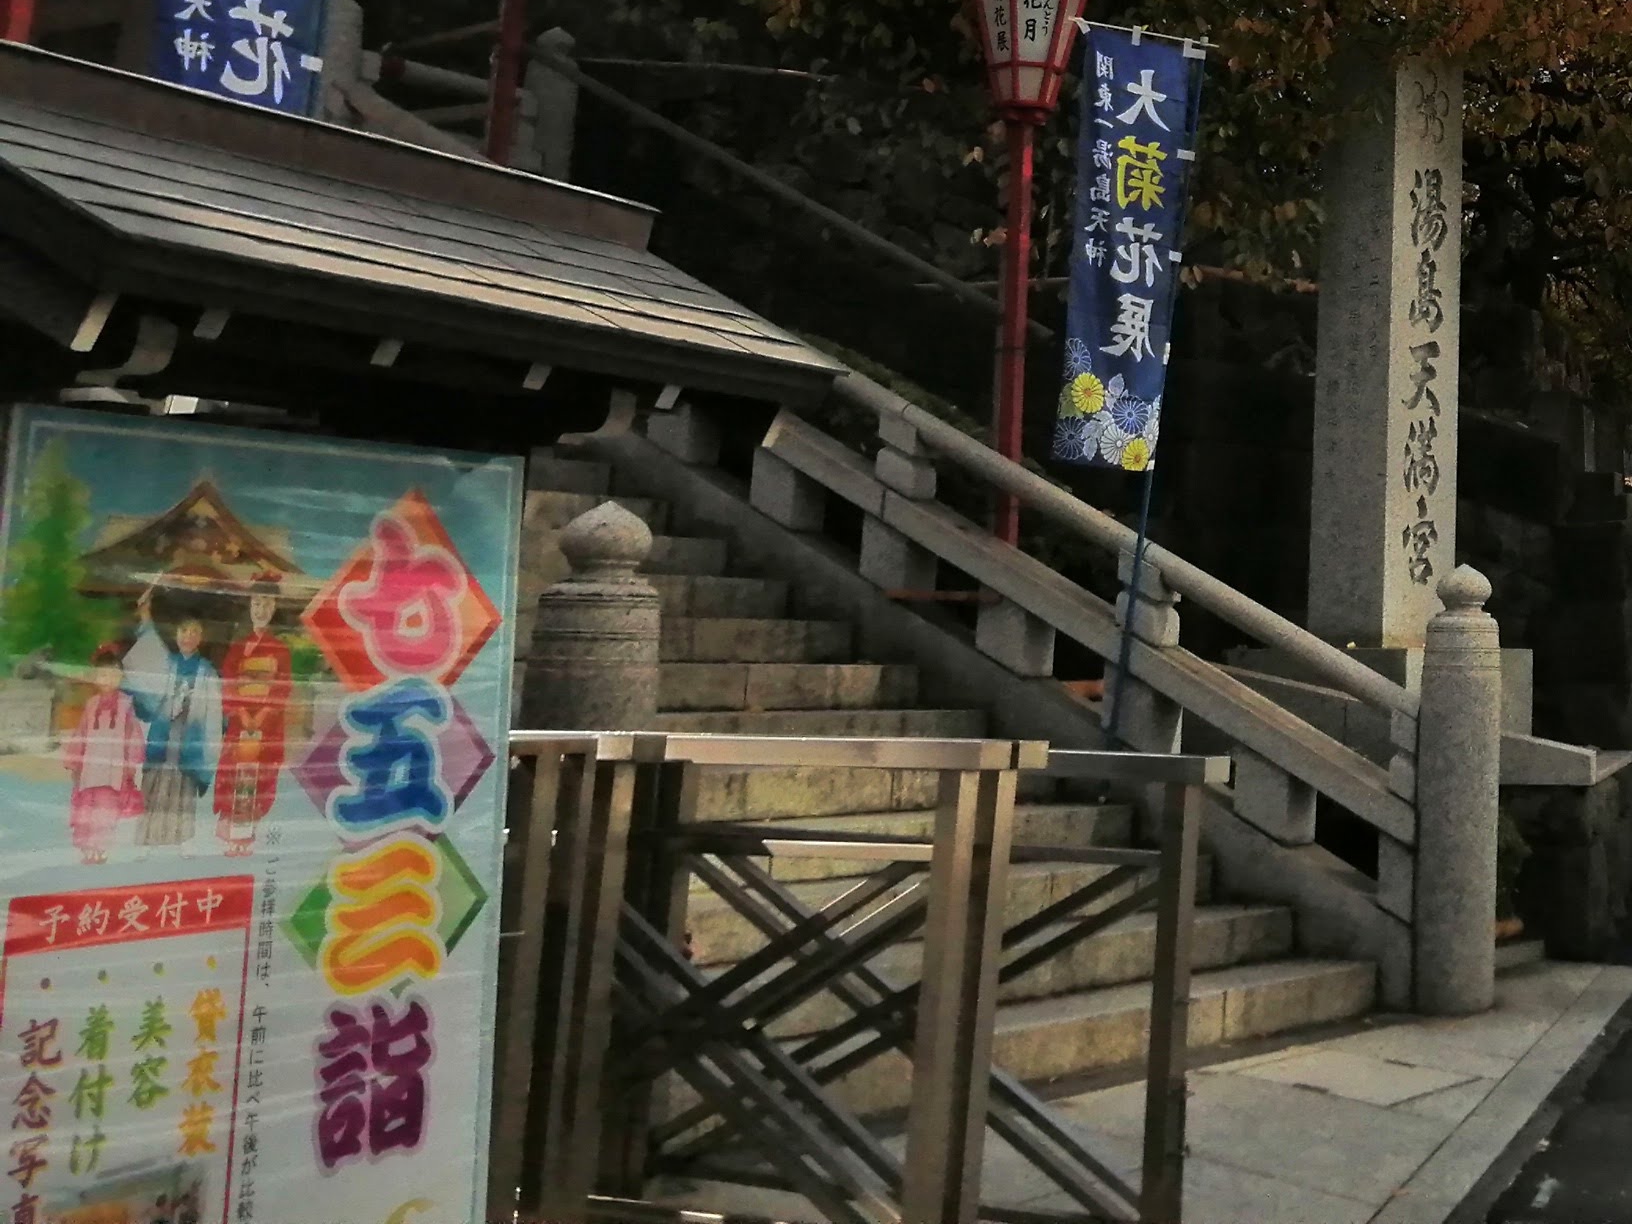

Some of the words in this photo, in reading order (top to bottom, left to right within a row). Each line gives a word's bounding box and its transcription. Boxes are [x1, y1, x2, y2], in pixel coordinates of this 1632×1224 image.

[1401, 168, 1448, 585] 湯島天満宮
[39, 889, 224, 944] 予約受付中
[318, 514, 466, 1174] 七五三詣
[68, 1003, 115, 1175] 着付け
[127, 995, 173, 1111] 美容
